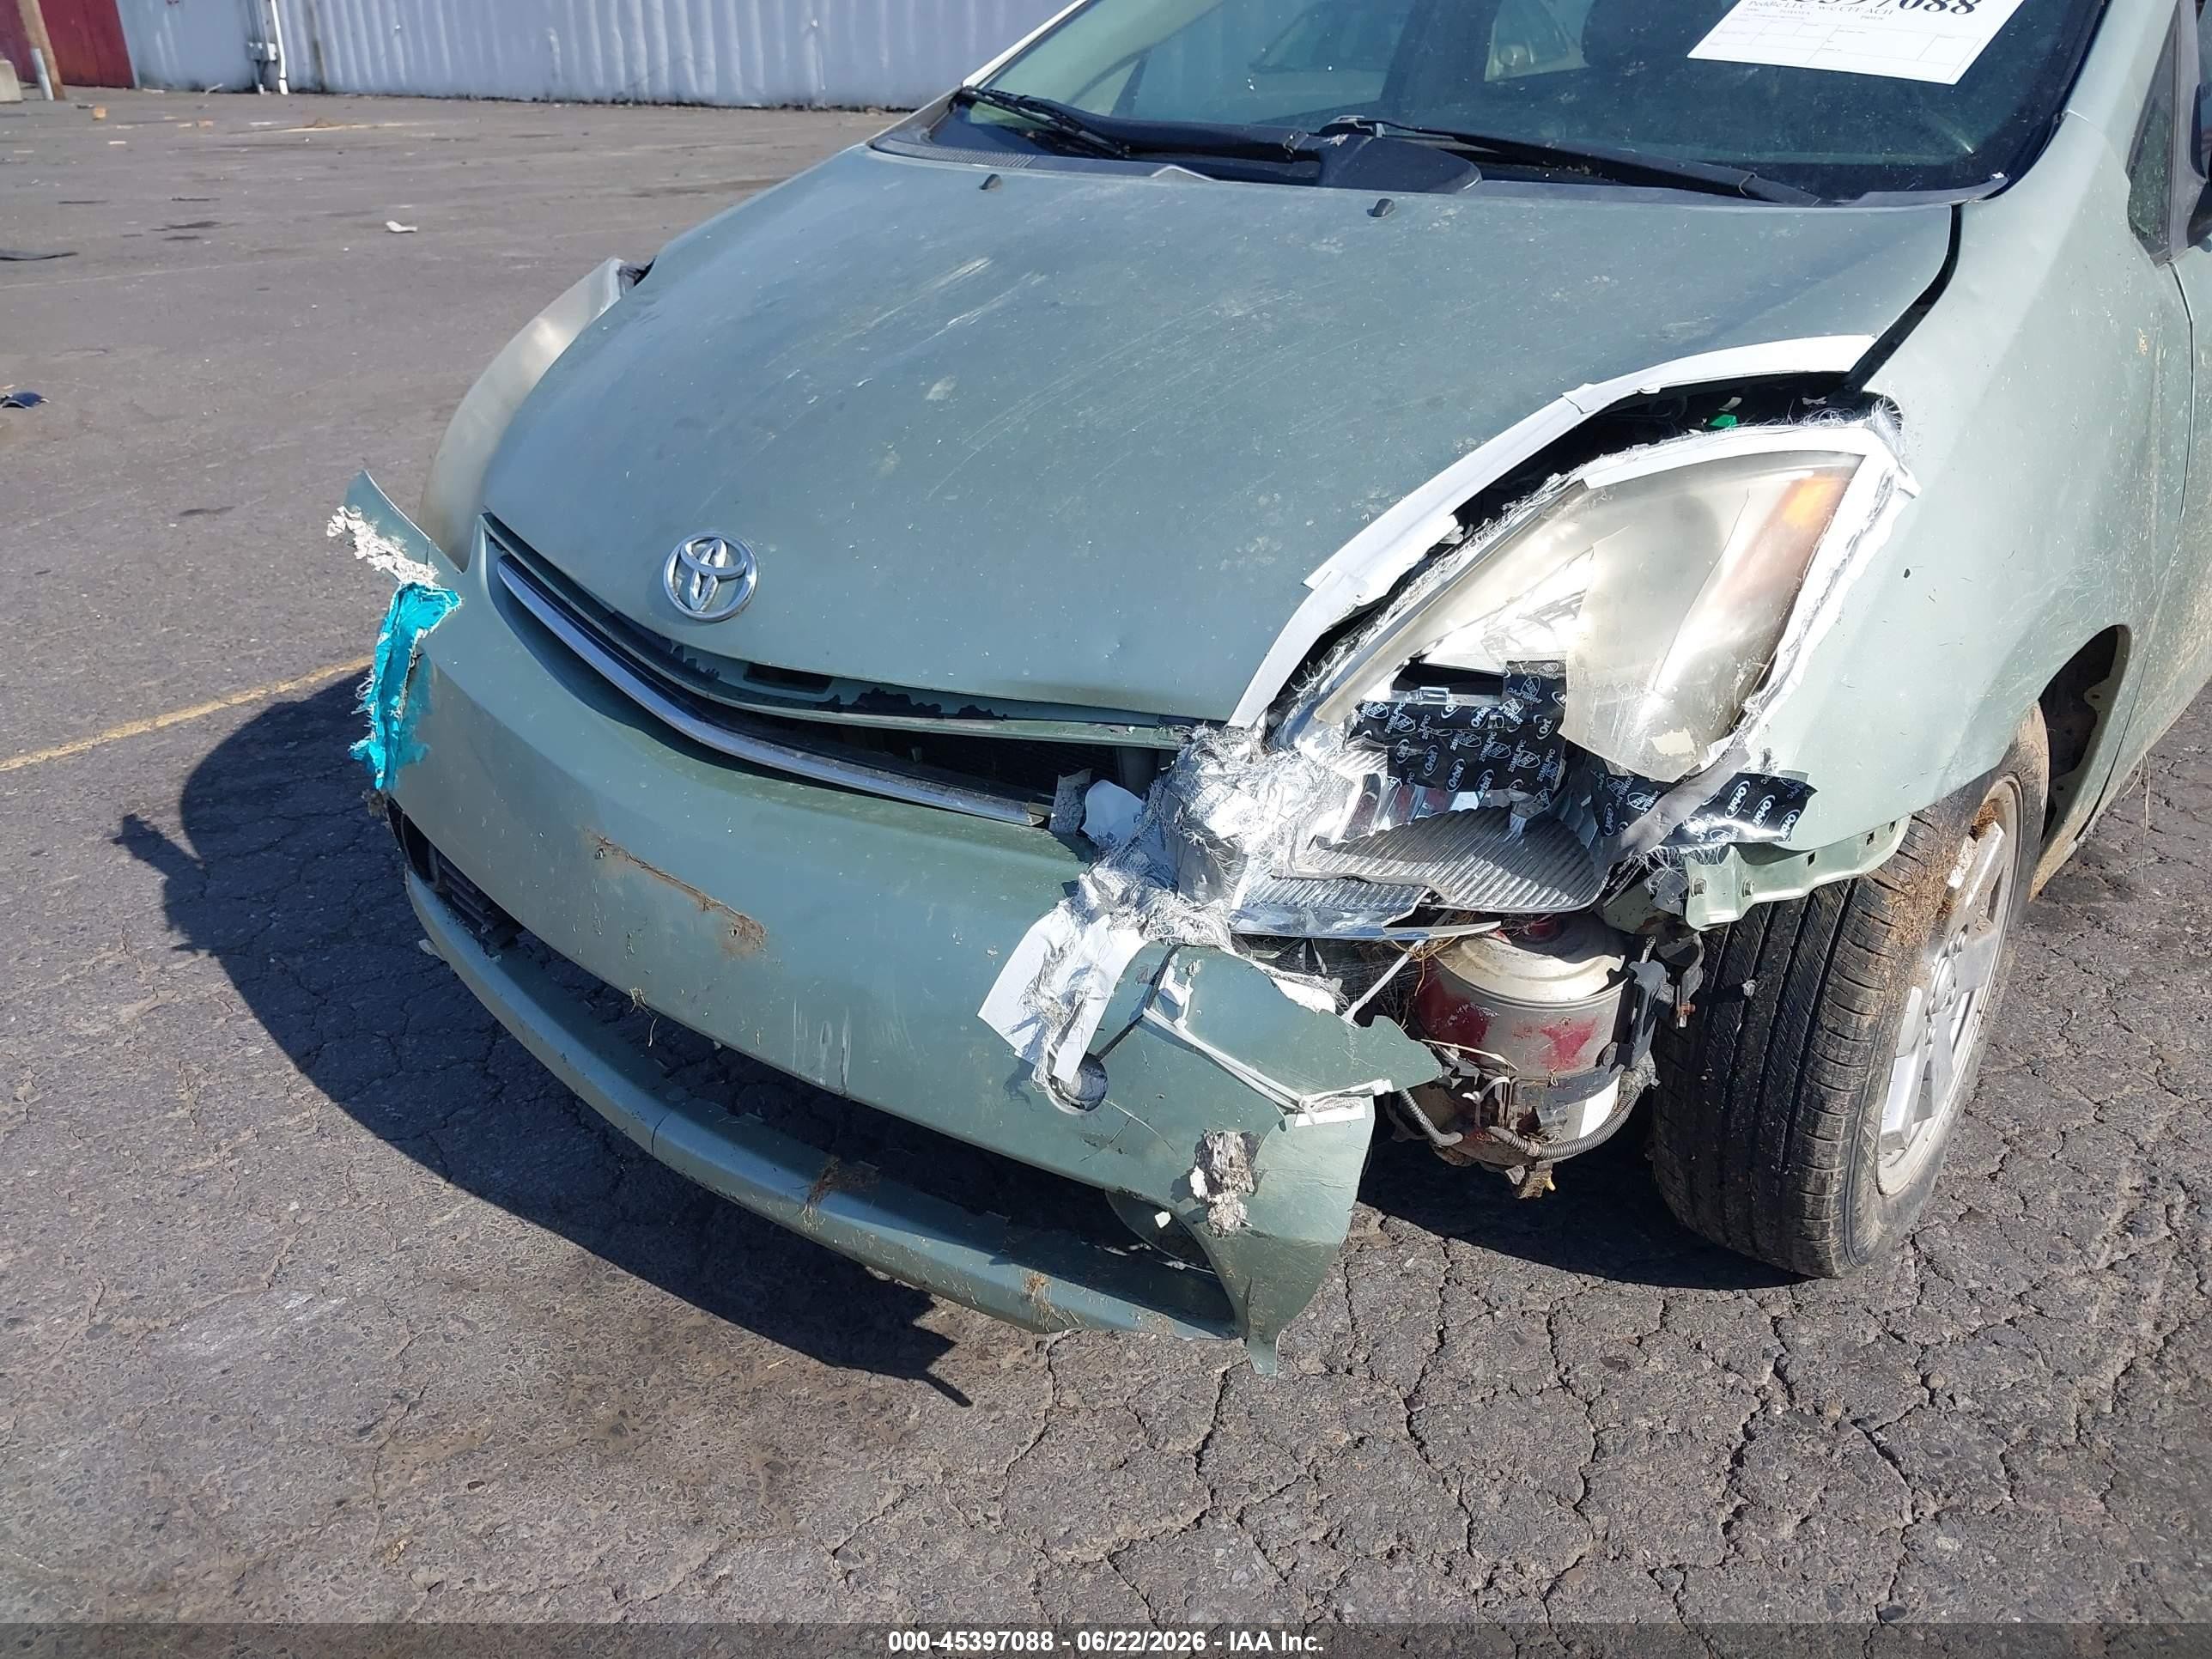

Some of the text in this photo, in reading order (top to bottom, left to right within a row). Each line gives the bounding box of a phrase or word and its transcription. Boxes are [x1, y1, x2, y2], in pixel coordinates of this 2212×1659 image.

[1470, 705, 1492, 728] Orbit
[1425, 748, 1438, 772] Orbit
[1448, 762, 1465, 788] Orbit
[1728, 786, 1747, 814] Orbit
[1752, 799, 1772, 827] Orbit
